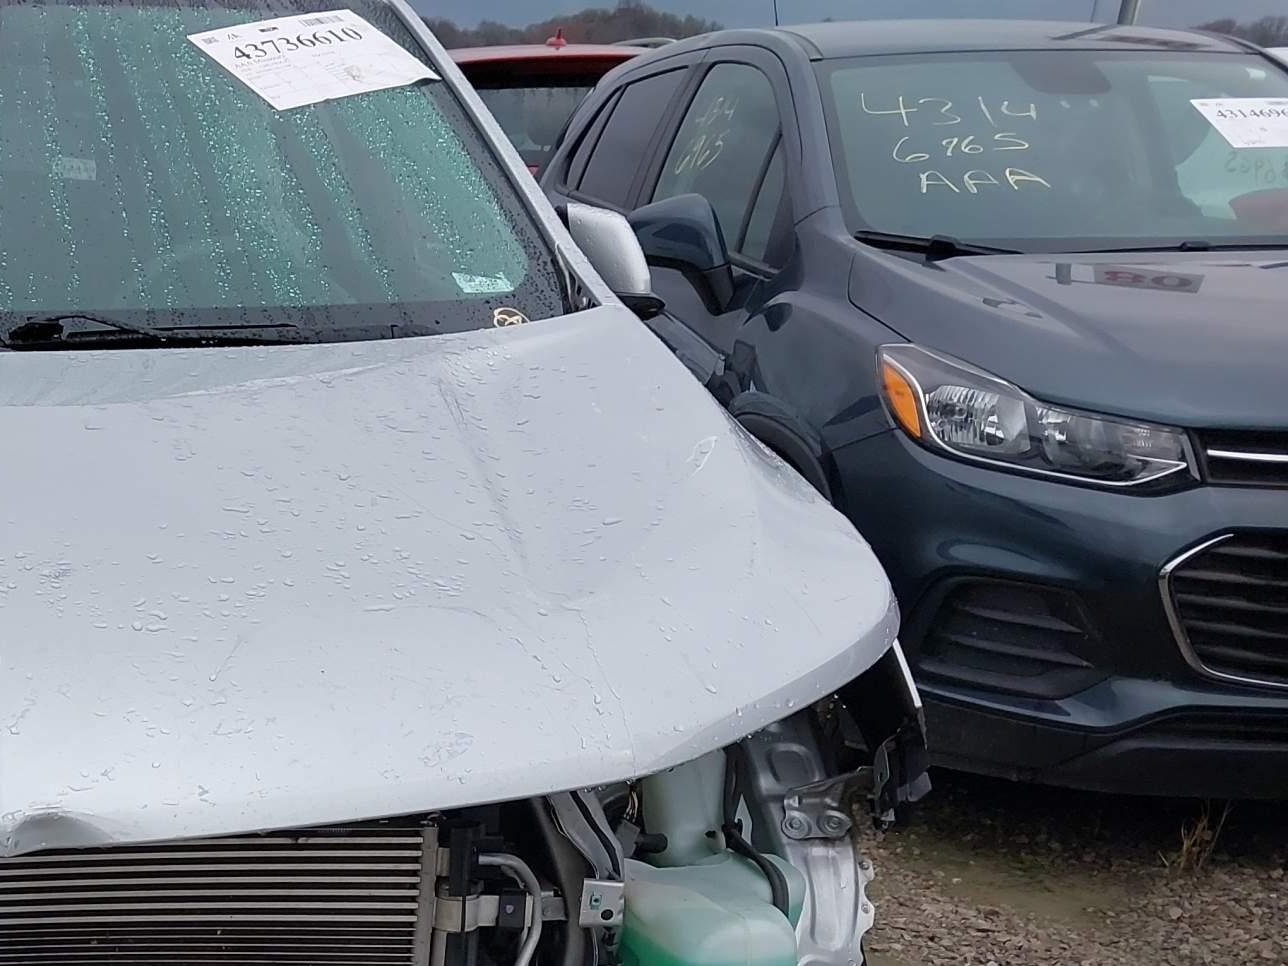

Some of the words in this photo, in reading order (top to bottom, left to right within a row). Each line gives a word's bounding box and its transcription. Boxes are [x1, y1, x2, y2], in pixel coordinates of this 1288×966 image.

[233, 27, 363, 61] 43736610
[861, 92, 1037, 127] 4314
[919, 167, 1051, 194] AAA
